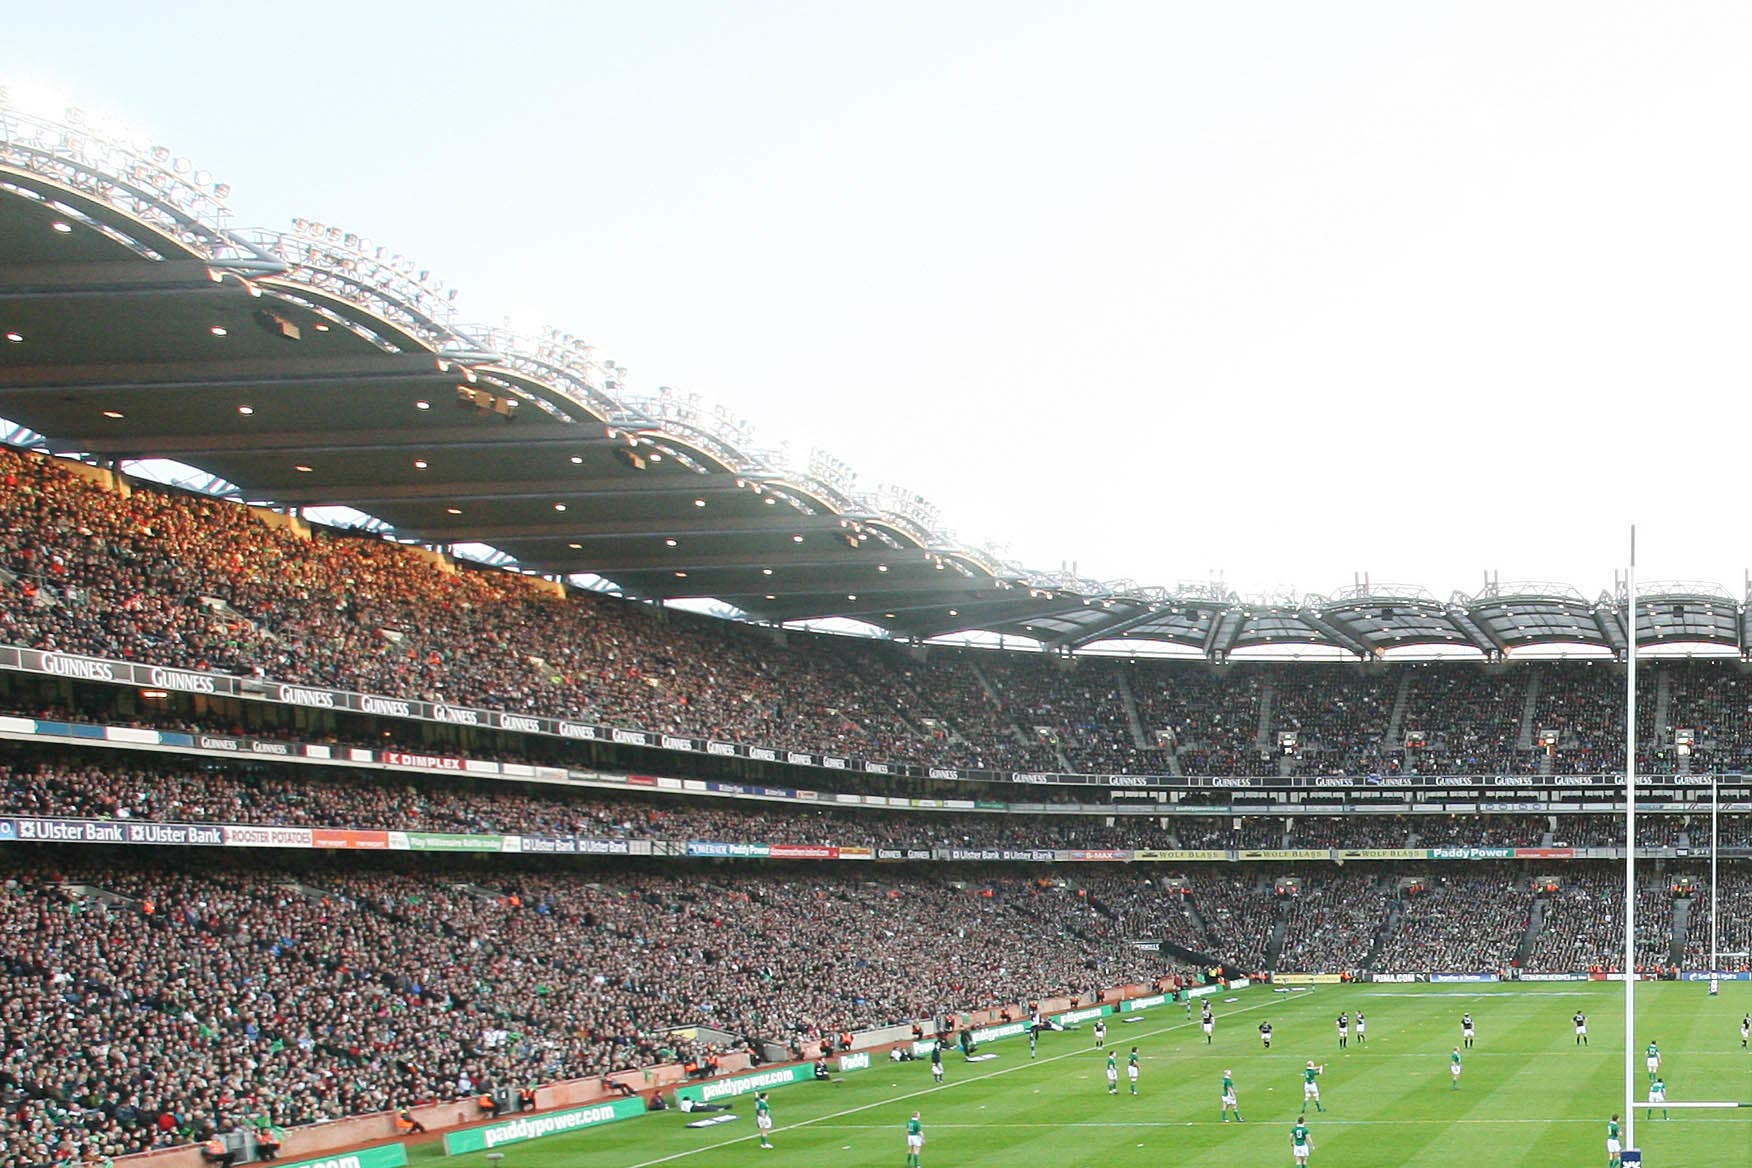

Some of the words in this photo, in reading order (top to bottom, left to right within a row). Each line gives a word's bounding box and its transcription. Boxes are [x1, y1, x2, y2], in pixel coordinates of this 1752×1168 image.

[42, 653, 112, 680] GUINNESS
[152, 668, 214, 692] GUINNESS
[280, 685, 334, 708] GUINNESS
[361, 696, 409, 716] GUINNESS
[500, 714, 540, 732] GUINNESS
[559, 721, 595, 738] GUINNESS
[202, 736, 238, 750] GUINNESS
[612, 728, 646, 745] GUINNESS
[662, 735, 692, 750] GUINNESS
[252, 740, 286, 754] GUINNESS
[402, 754, 460, 770] DIMPLEX
[929, 768, 958, 780] GUINNESS
[1012, 772, 1047, 784] GUINNESS
[1109, 775, 1147, 786] GUINNESS
[1435, 776, 1472, 786] GUINNESS
[1494, 776, 1532, 786] GUINNESS
[1554, 776, 1592, 786] GUINNESS
[1674, 775, 1712, 785] GUINNESS
[1212, 777, 1251, 786] GUINNESS
[1315, 777, 1353, 786] GUINNESS
[36, 823, 82, 840] Ulster
[86, 824, 122, 841] Bank
[145, 827, 186, 842] Ulster
[188, 828, 221, 844] Bank
[232, 830, 269, 842] ROOSTER
[272, 832, 312, 844] POTATOES
[533, 840, 554, 850] Ulster
[556, 840, 576, 850] Bank
[588, 841, 608, 851] Ulster
[610, 841, 628, 851] Bank
[960, 850, 982, 860] Ulster
[982, 850, 1001, 860] Bank
[1010, 850, 1032, 860] Ulster
[1033, 850, 1054, 860] Bank
[1434, 849, 1470, 858] Paddy
[1471, 848, 1508, 857] Power
[840, 1052, 870, 1070] Paddy
[702, 1068, 794, 1102] paddypower.com
[485, 1104, 614, 1148] paddypower.com
